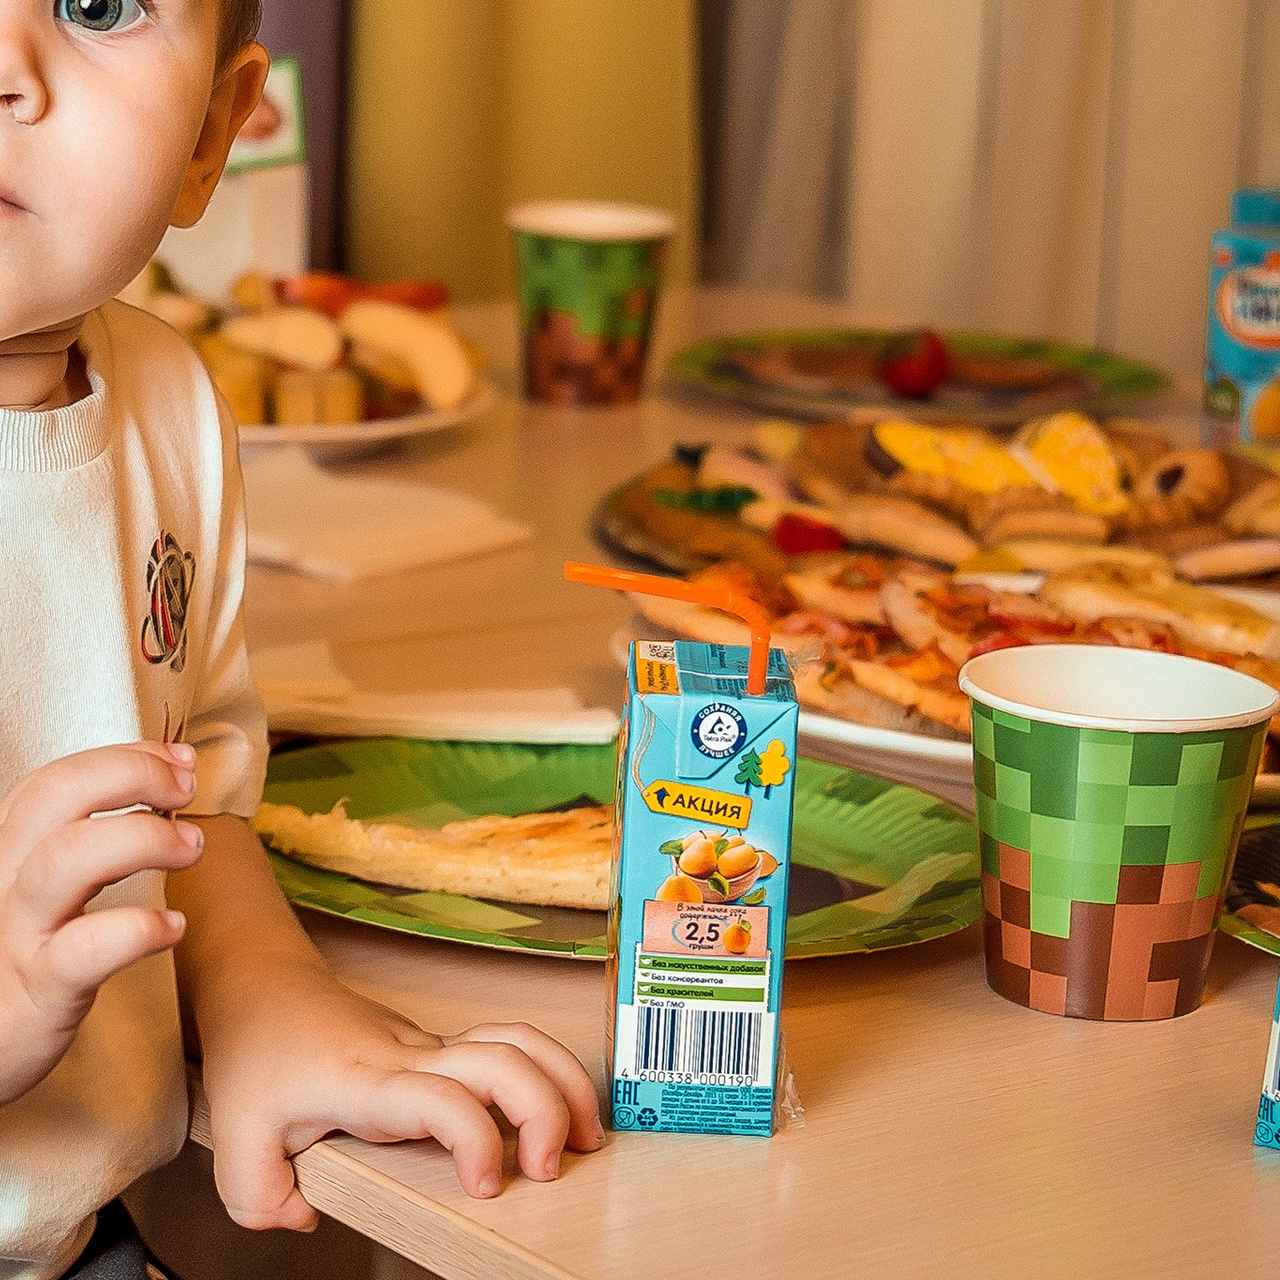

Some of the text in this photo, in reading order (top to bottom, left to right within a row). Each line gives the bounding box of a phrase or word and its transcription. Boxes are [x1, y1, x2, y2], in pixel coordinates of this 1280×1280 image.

[698, 702, 742, 722] СОХРАНЯЯ
[703, 734, 719, 742] Tetra
[699, 744, 735, 758] ЛУЧШЕЕ
[672, 793, 742, 820] АКЦИЯ
[677, 903, 684, 912] В
[686, 922, 720, 944] 2,5
[689, 943, 714, 951] груши
[652, 959, 764, 973] Без искусственных добавок
[651, 973, 724, 985] Без консервантов
[650, 986, 714, 998] Без красителей
[649, 999, 685, 1009] Без ГМО
[621, 1068, 753, 1087] 4 600338 000190
